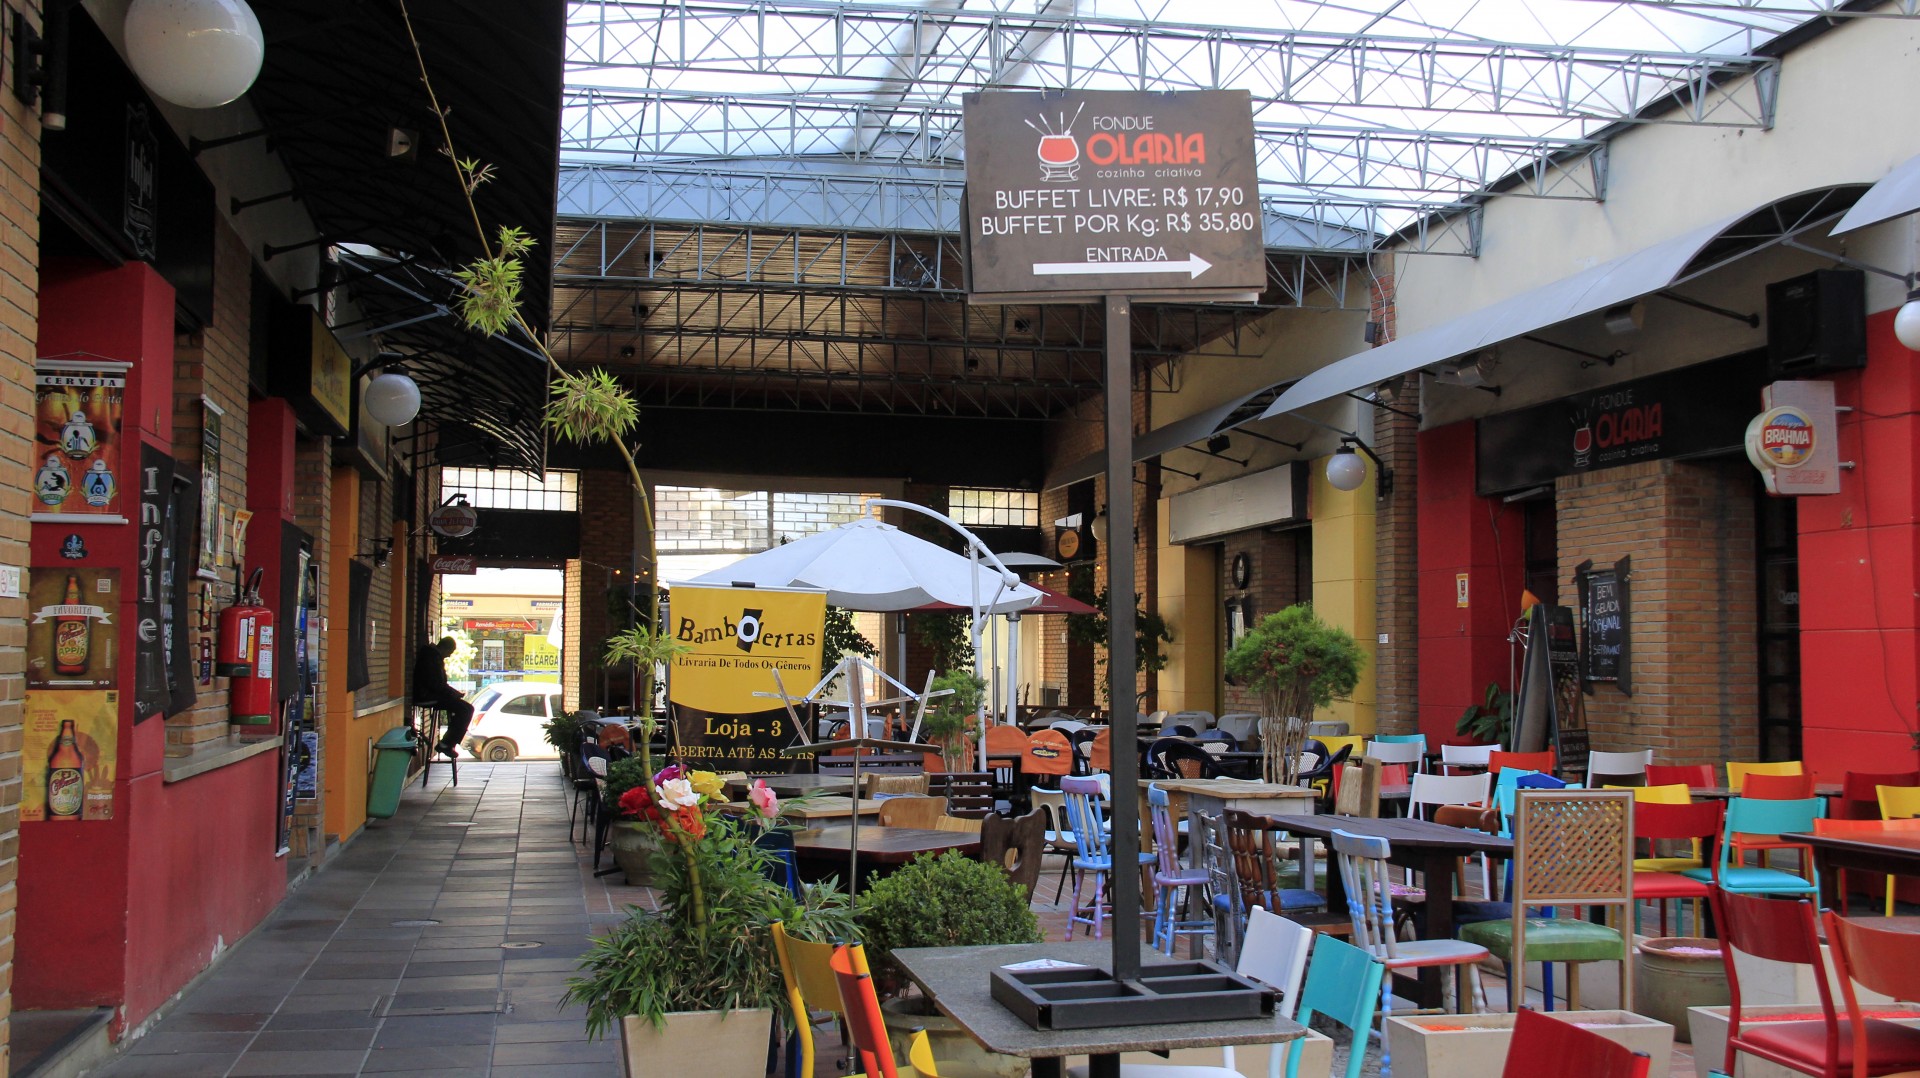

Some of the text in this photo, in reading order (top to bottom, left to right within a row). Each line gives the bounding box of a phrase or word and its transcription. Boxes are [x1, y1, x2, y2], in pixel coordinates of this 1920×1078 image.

[1093, 116, 1153, 130] FONDUE
[1086, 132, 1206, 165] OLARIA
[1097, 166, 1201, 178] cozinha criativa
[996, 186, 1244, 209] BUFFET LIVRE: R$ 17,90
[982, 212, 1254, 237] BUFFET POR Kg: R$ 35,80
[1086, 247, 1168, 262] ENTRADA
[44, 376, 116, 387] CERVEJA
[1600, 389, 1633, 411] FONDUE
[1596, 402, 1663, 448] OLARIA
[1765, 428, 1810, 445] BRAHMA
[1596, 584, 1612, 600] BEM
[53, 606, 92, 614] FAVORITA
[525, 654, 558, 666] RECARGA
[678, 656, 811, 670] Livraria De Todos Os Gêneros
[704, 718, 751, 740] Loja
[771, 720, 782, 736] 3
[668, 745, 724, 758] ABERTA
[727, 744, 755, 759] ATÉ
[758, 747, 776, 760] AS
